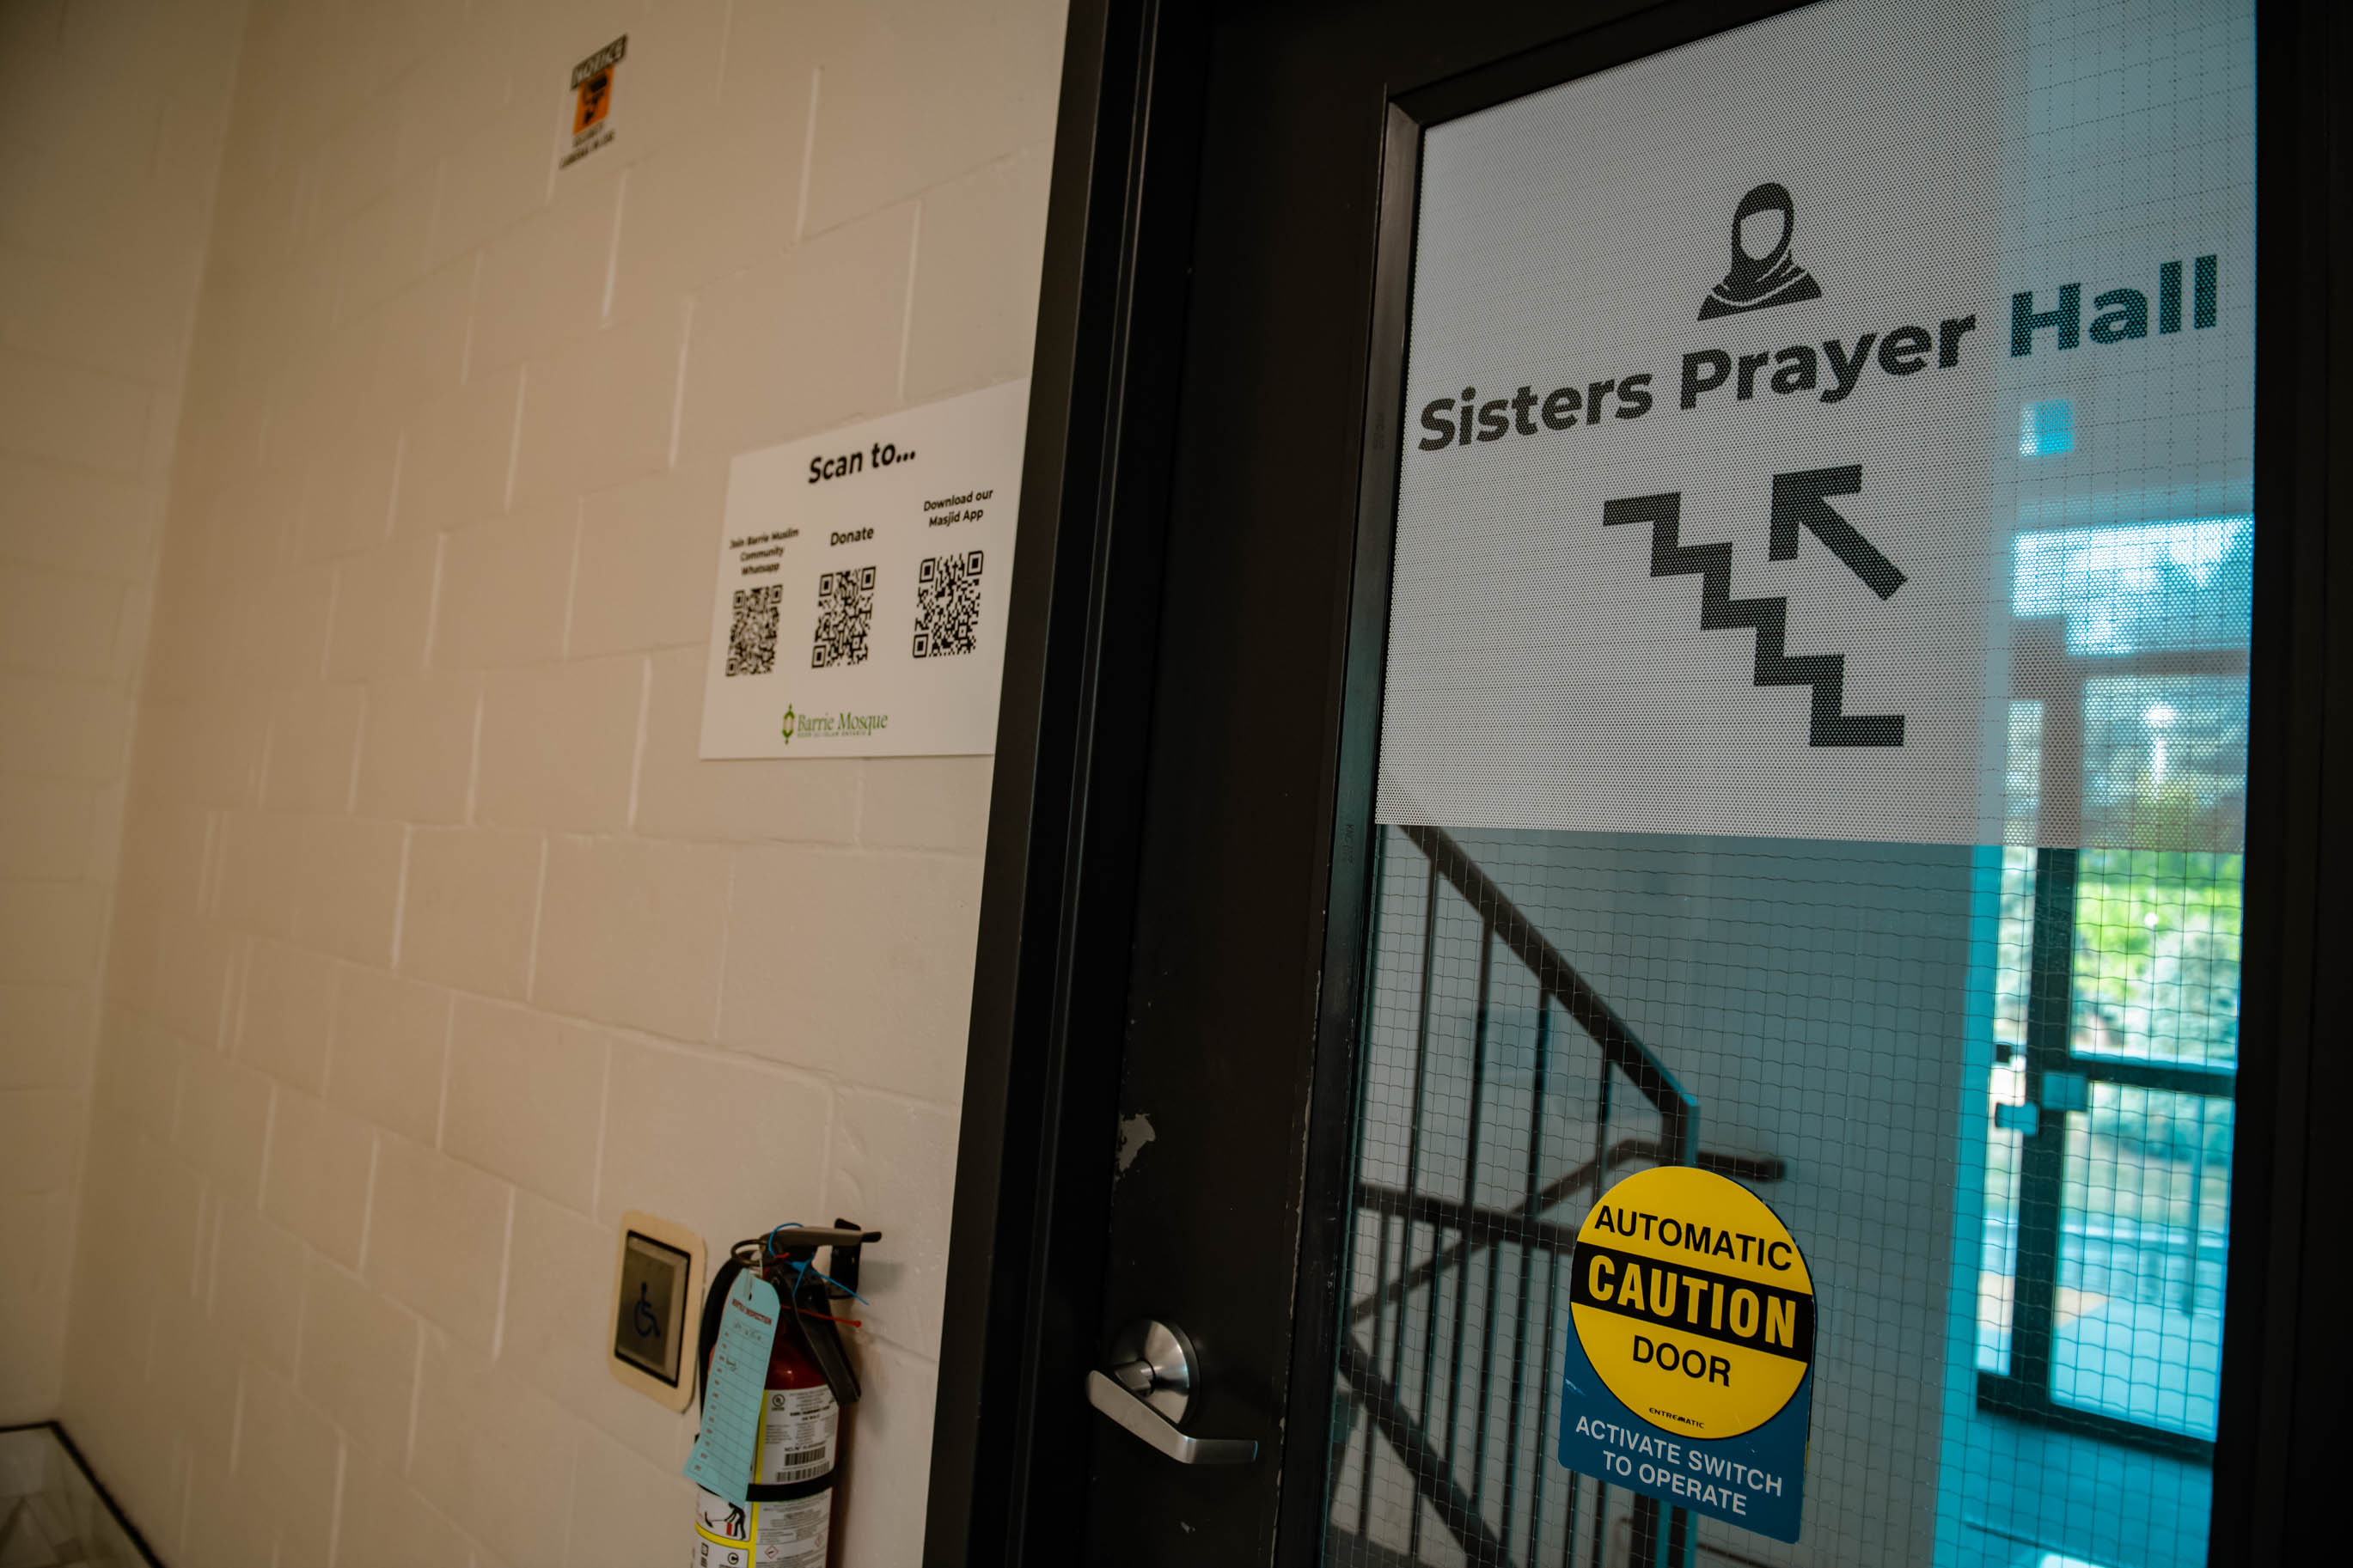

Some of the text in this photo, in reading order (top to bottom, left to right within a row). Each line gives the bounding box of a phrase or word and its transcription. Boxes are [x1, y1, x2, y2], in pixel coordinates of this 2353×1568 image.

[1418, 254, 2218, 452] Sisters Prayer Hall
[808, 442, 916, 484] Scan to...
[923, 490, 993, 512] Download our
[929, 509, 983, 528] Masjid App
[748, 534, 768, 546] Barrie
[772, 528, 799, 540] Muslim
[830, 527, 874, 546] Donate
[740, 546, 784, 561] Community
[798, 711, 889, 736] Barrie Mosque
[1594, 1205, 1793, 1271] AUTOMATIC
[1588, 1254, 1797, 1348] CAUTION
[1633, 1335, 1731, 1387] DOOR
[1648, 1406, 1705, 1430] ENTREMATIC
[1575, 1415, 1782, 1497] ACTIVATE SWITCH
[1603, 1449, 1747, 1516] TO OPERATE
